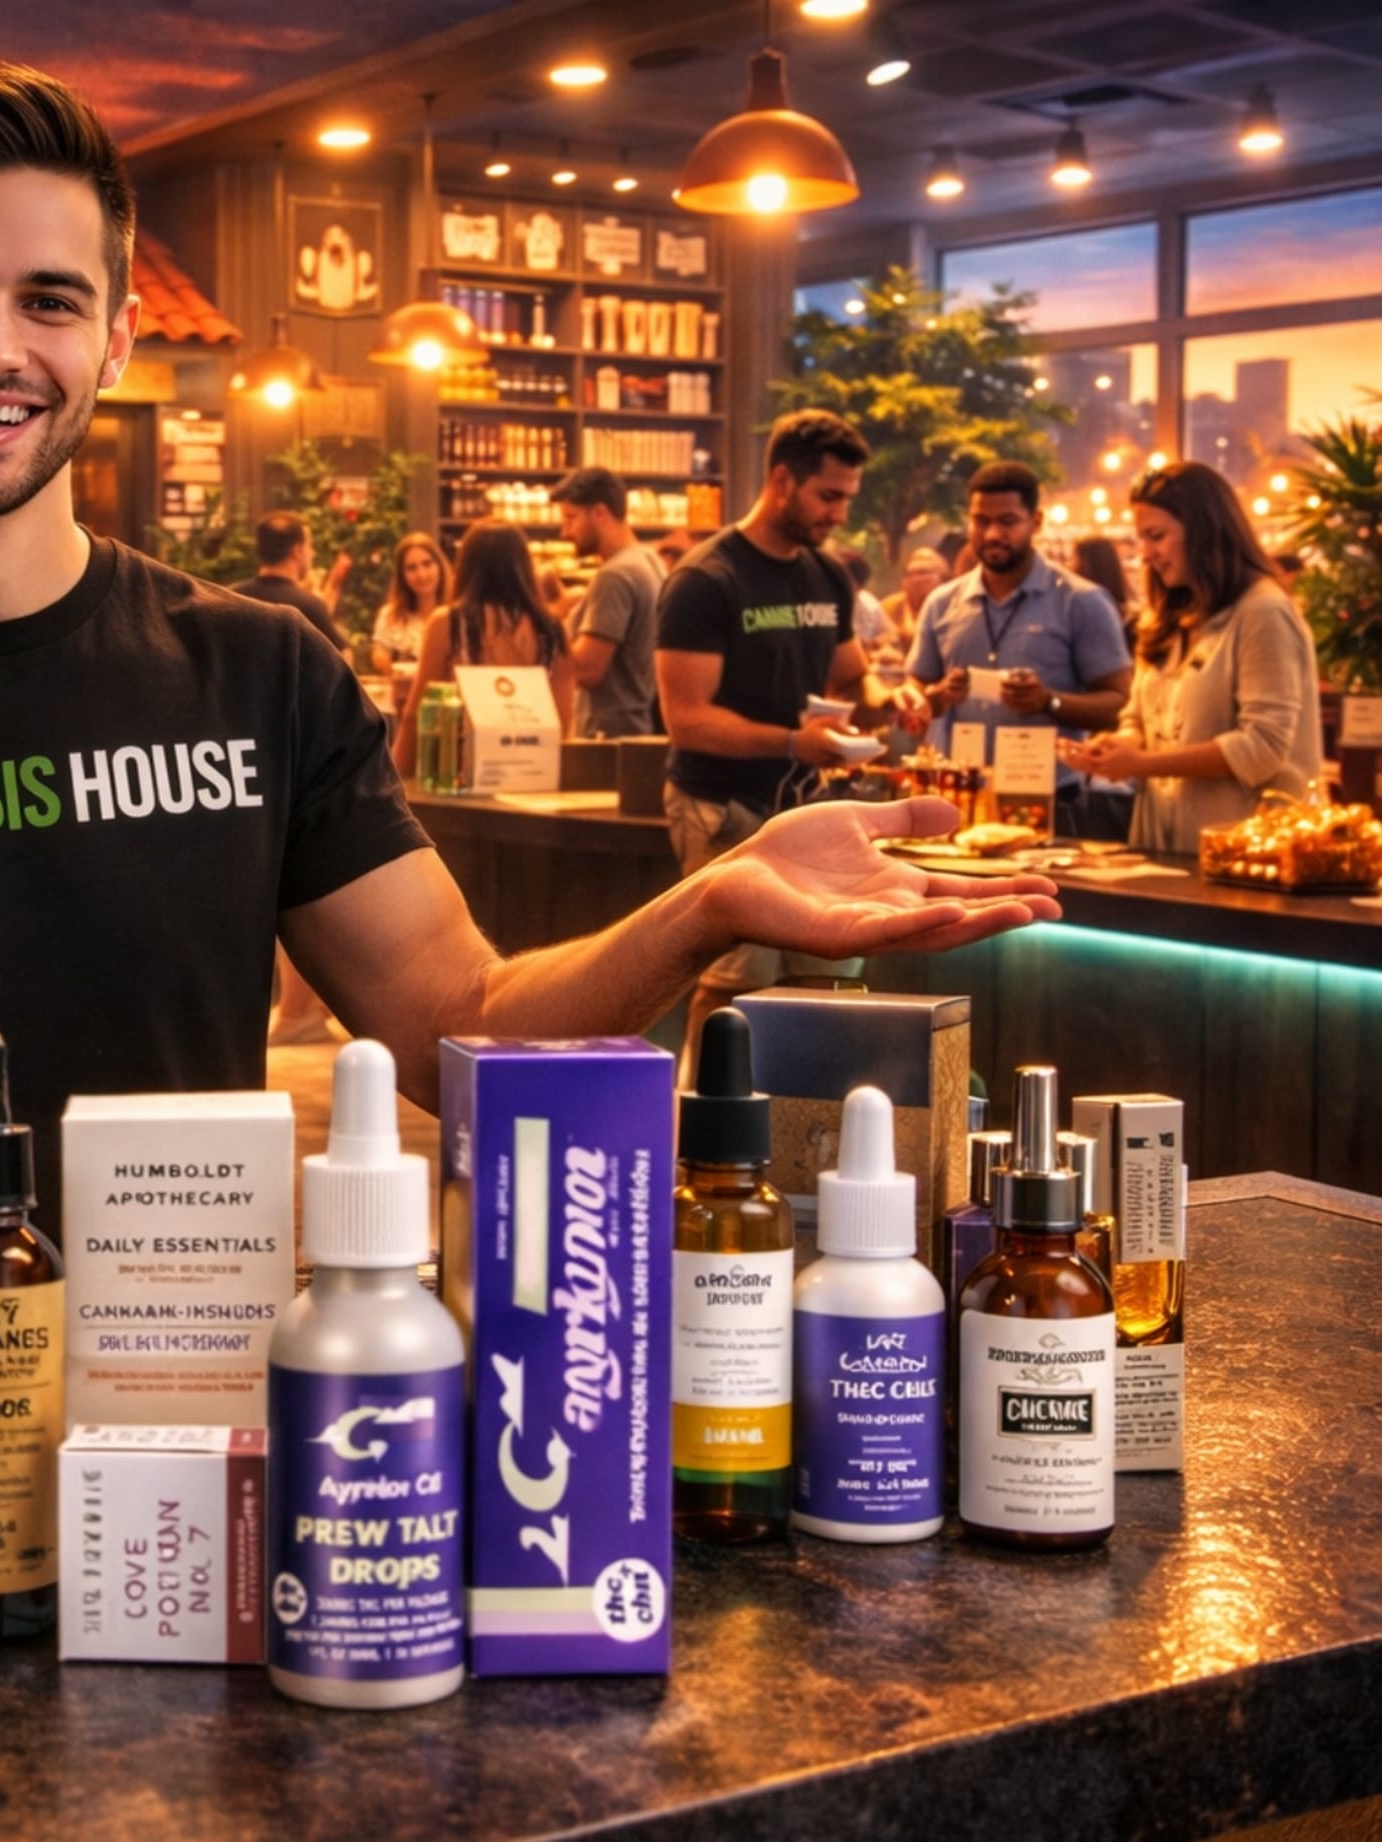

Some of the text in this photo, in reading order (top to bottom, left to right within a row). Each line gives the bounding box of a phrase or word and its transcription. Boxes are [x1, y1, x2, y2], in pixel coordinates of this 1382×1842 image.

[69, 738, 263, 823] HOUSE
[114, 1164, 245, 1179] HUMBOLDT
[86, 1237, 277, 1254] DAILY ESSENTIALS
[296, 1516, 389, 1548] PREW
